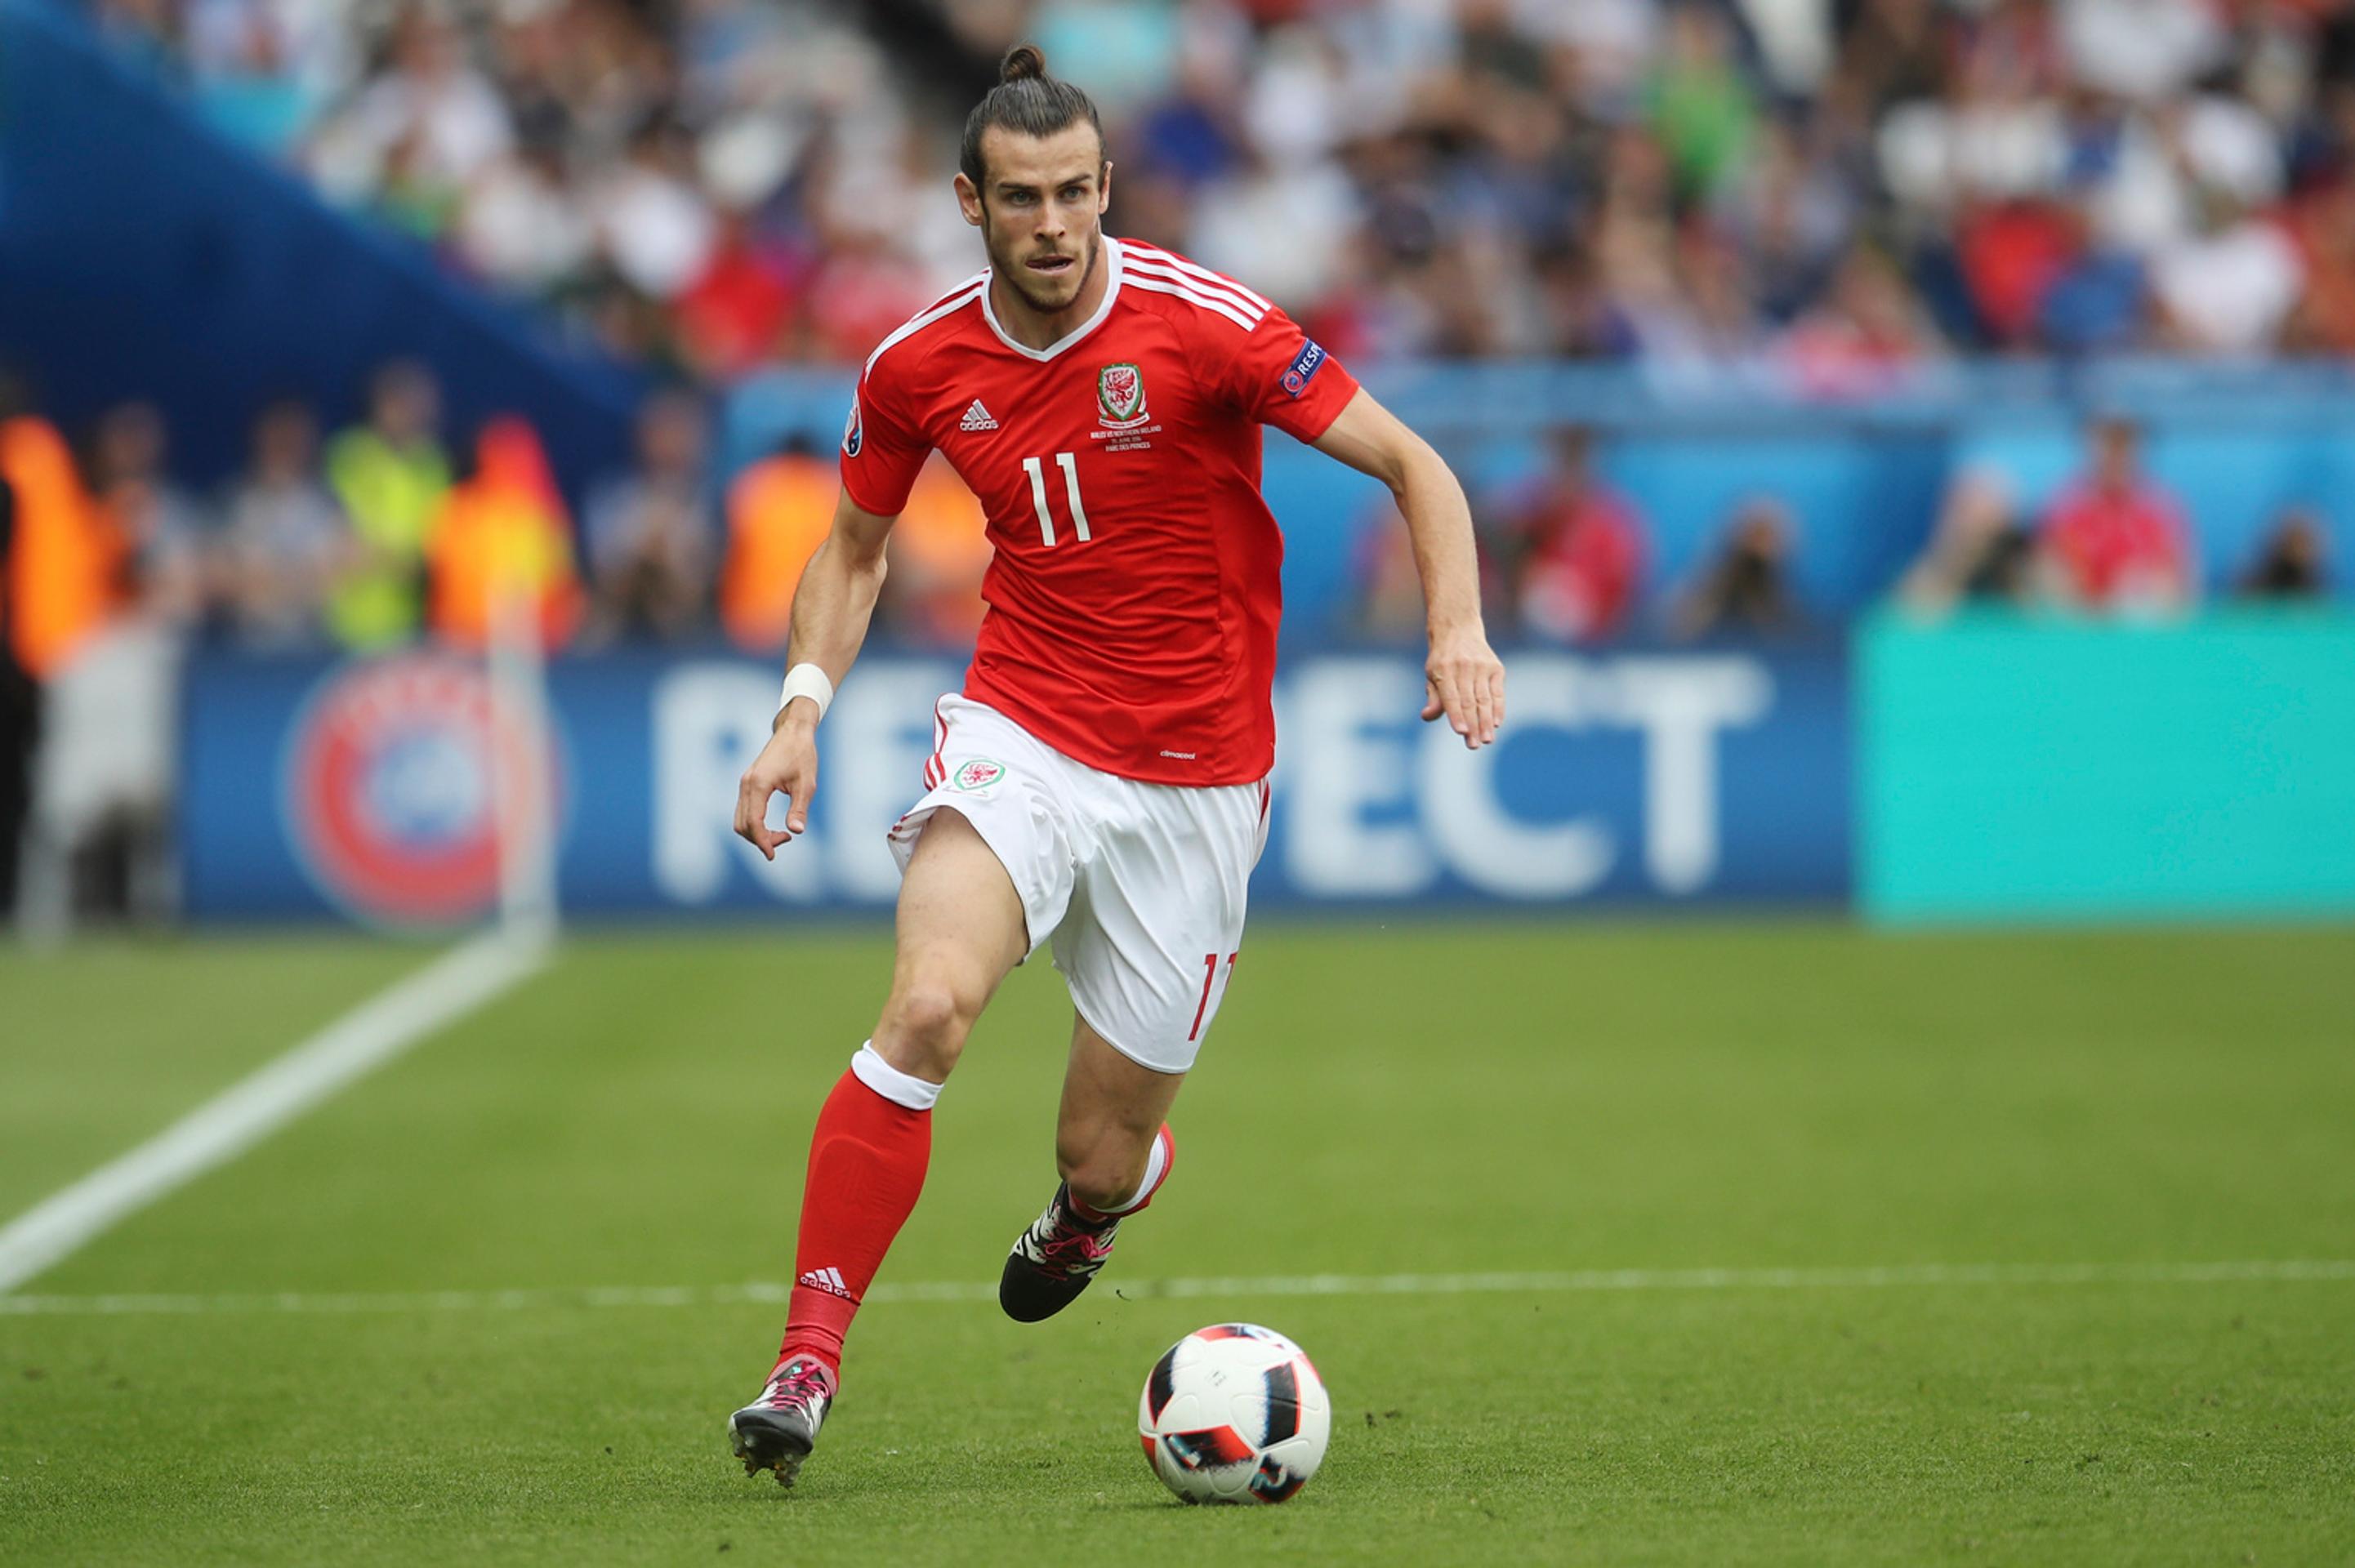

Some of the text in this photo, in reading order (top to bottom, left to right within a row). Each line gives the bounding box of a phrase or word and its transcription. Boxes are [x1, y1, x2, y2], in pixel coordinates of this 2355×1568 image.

[959, 419, 999, 431] adidas
[1023, 452, 1091, 547] 11
[656, 658, 1773, 897] REECT
[800, 1276, 850, 1298] adidas
